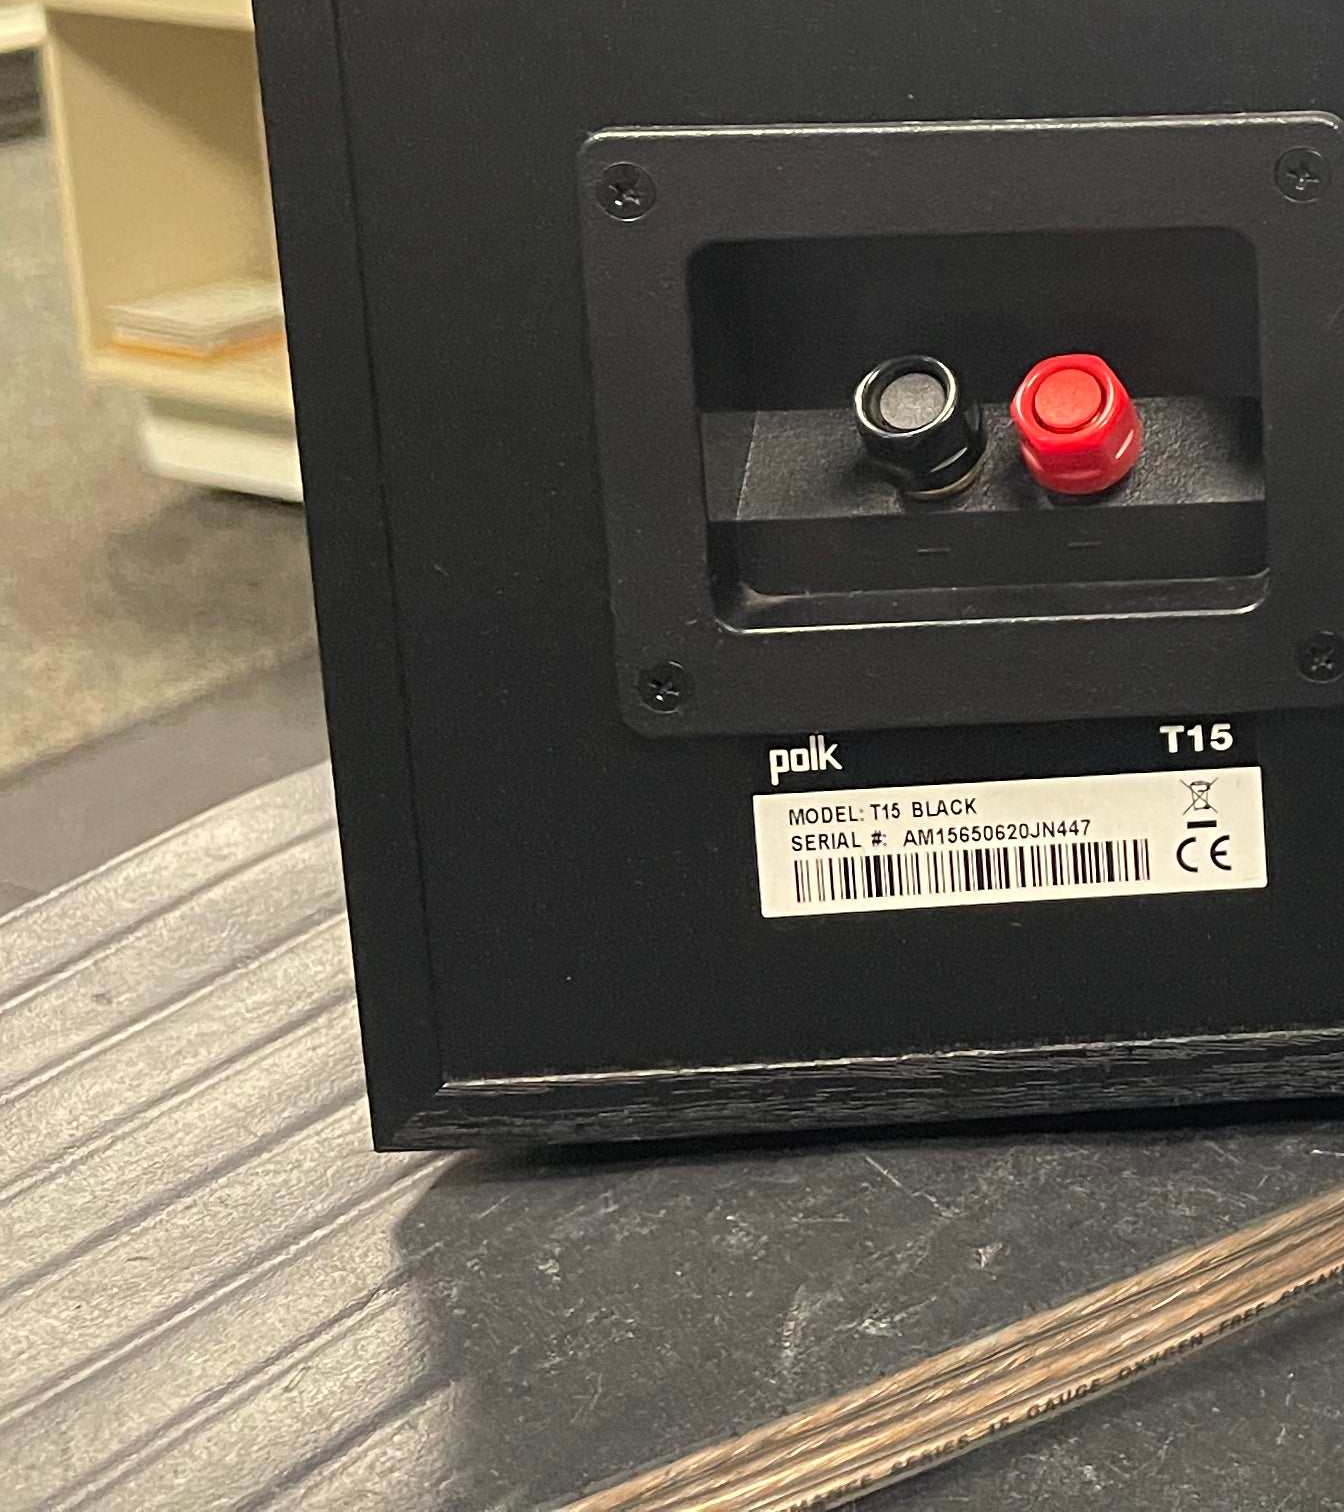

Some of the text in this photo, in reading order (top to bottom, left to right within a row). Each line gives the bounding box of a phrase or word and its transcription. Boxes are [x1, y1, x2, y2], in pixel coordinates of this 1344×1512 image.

[1159, 723, 1234, 754] T15
[769, 734, 843, 786] polk
[788, 797, 977, 826] MODEL: T15 BLACK
[790, 831, 862, 852] SERIAL
[902, 818, 1092, 848] AM15650620JN447
[1176, 834, 1232, 873] CE
[1026, 1378, 1102, 1419] GAUGE
[1118, 1332, 1204, 1378] OXYGEN
[1219, 1301, 1266, 1334] FREE
